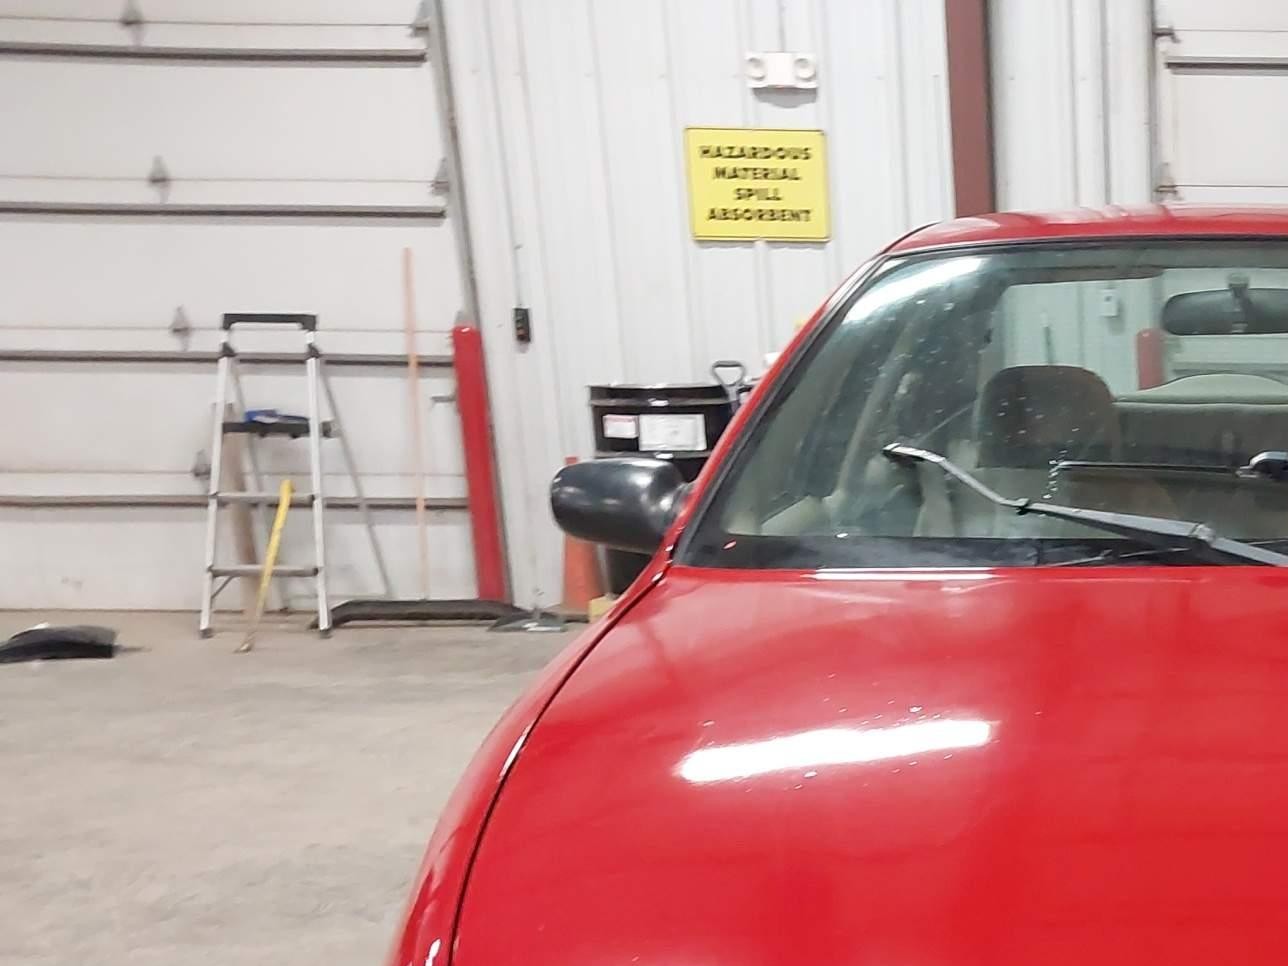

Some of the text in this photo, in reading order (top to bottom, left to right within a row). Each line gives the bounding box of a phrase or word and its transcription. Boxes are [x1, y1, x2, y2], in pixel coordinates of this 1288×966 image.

[698, 145, 813, 160] HAZARDOUS
[713, 167, 802, 180] MATERIAL
[733, 187, 784, 201] SPILL
[706, 208, 812, 222] ABSORBENT
